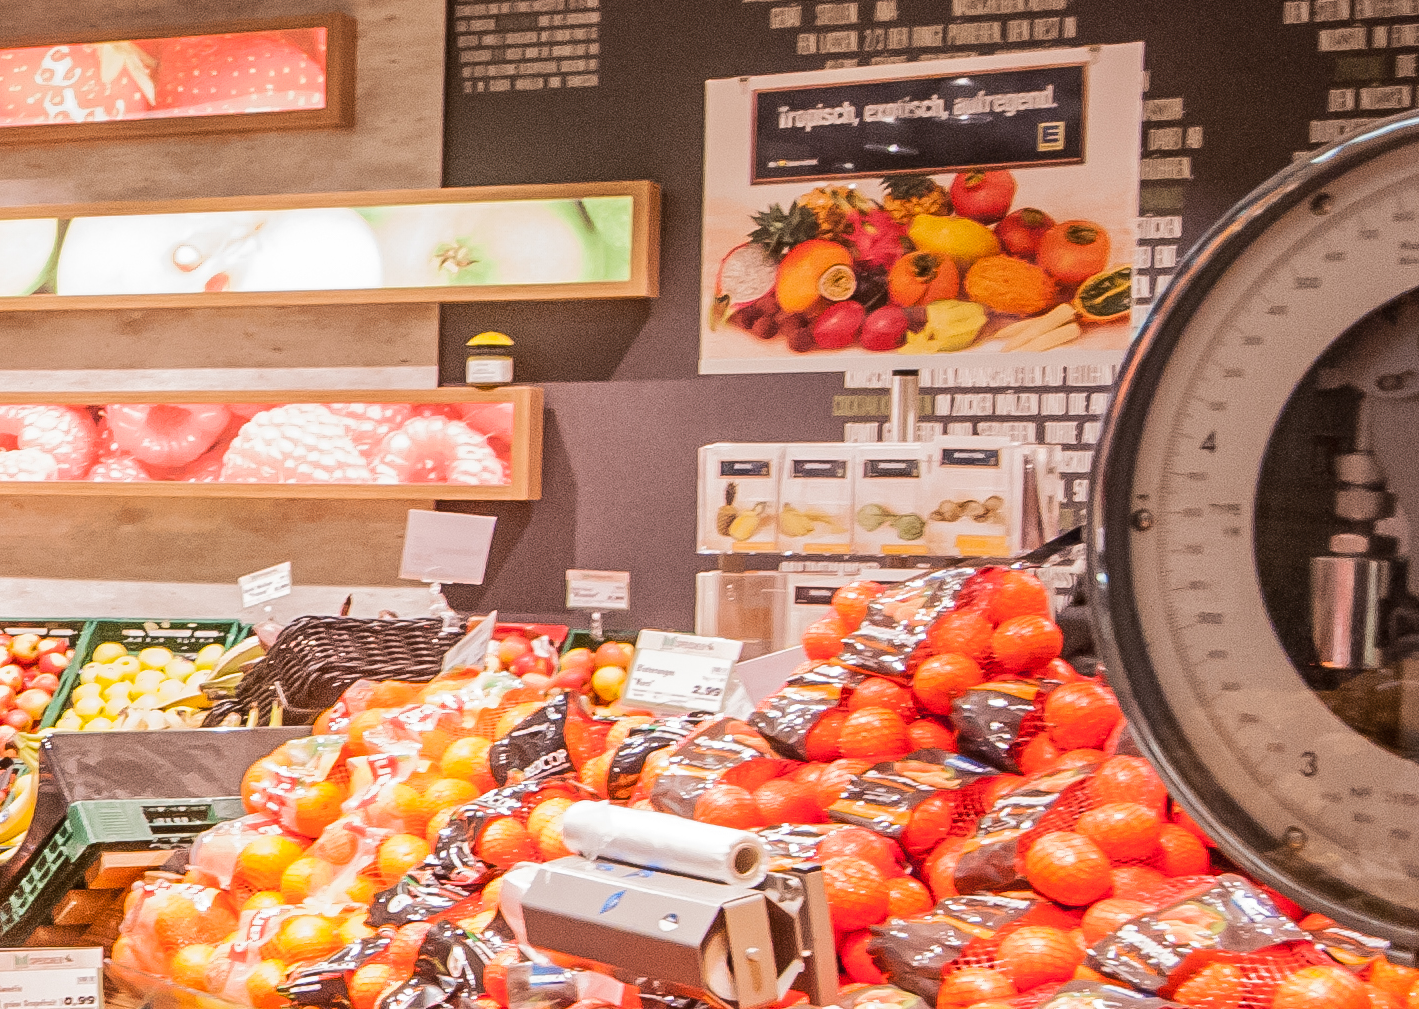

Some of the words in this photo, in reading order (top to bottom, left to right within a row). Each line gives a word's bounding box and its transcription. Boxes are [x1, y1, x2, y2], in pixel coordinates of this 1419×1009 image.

[776, 102, 860, 132] Tropisch,
[864, 97, 950, 123] exotisch,
[951, 85, 1059, 117] aufregend.
[1199, 430, 1217, 453] 4
[1300, 751, 1317, 777] 3
